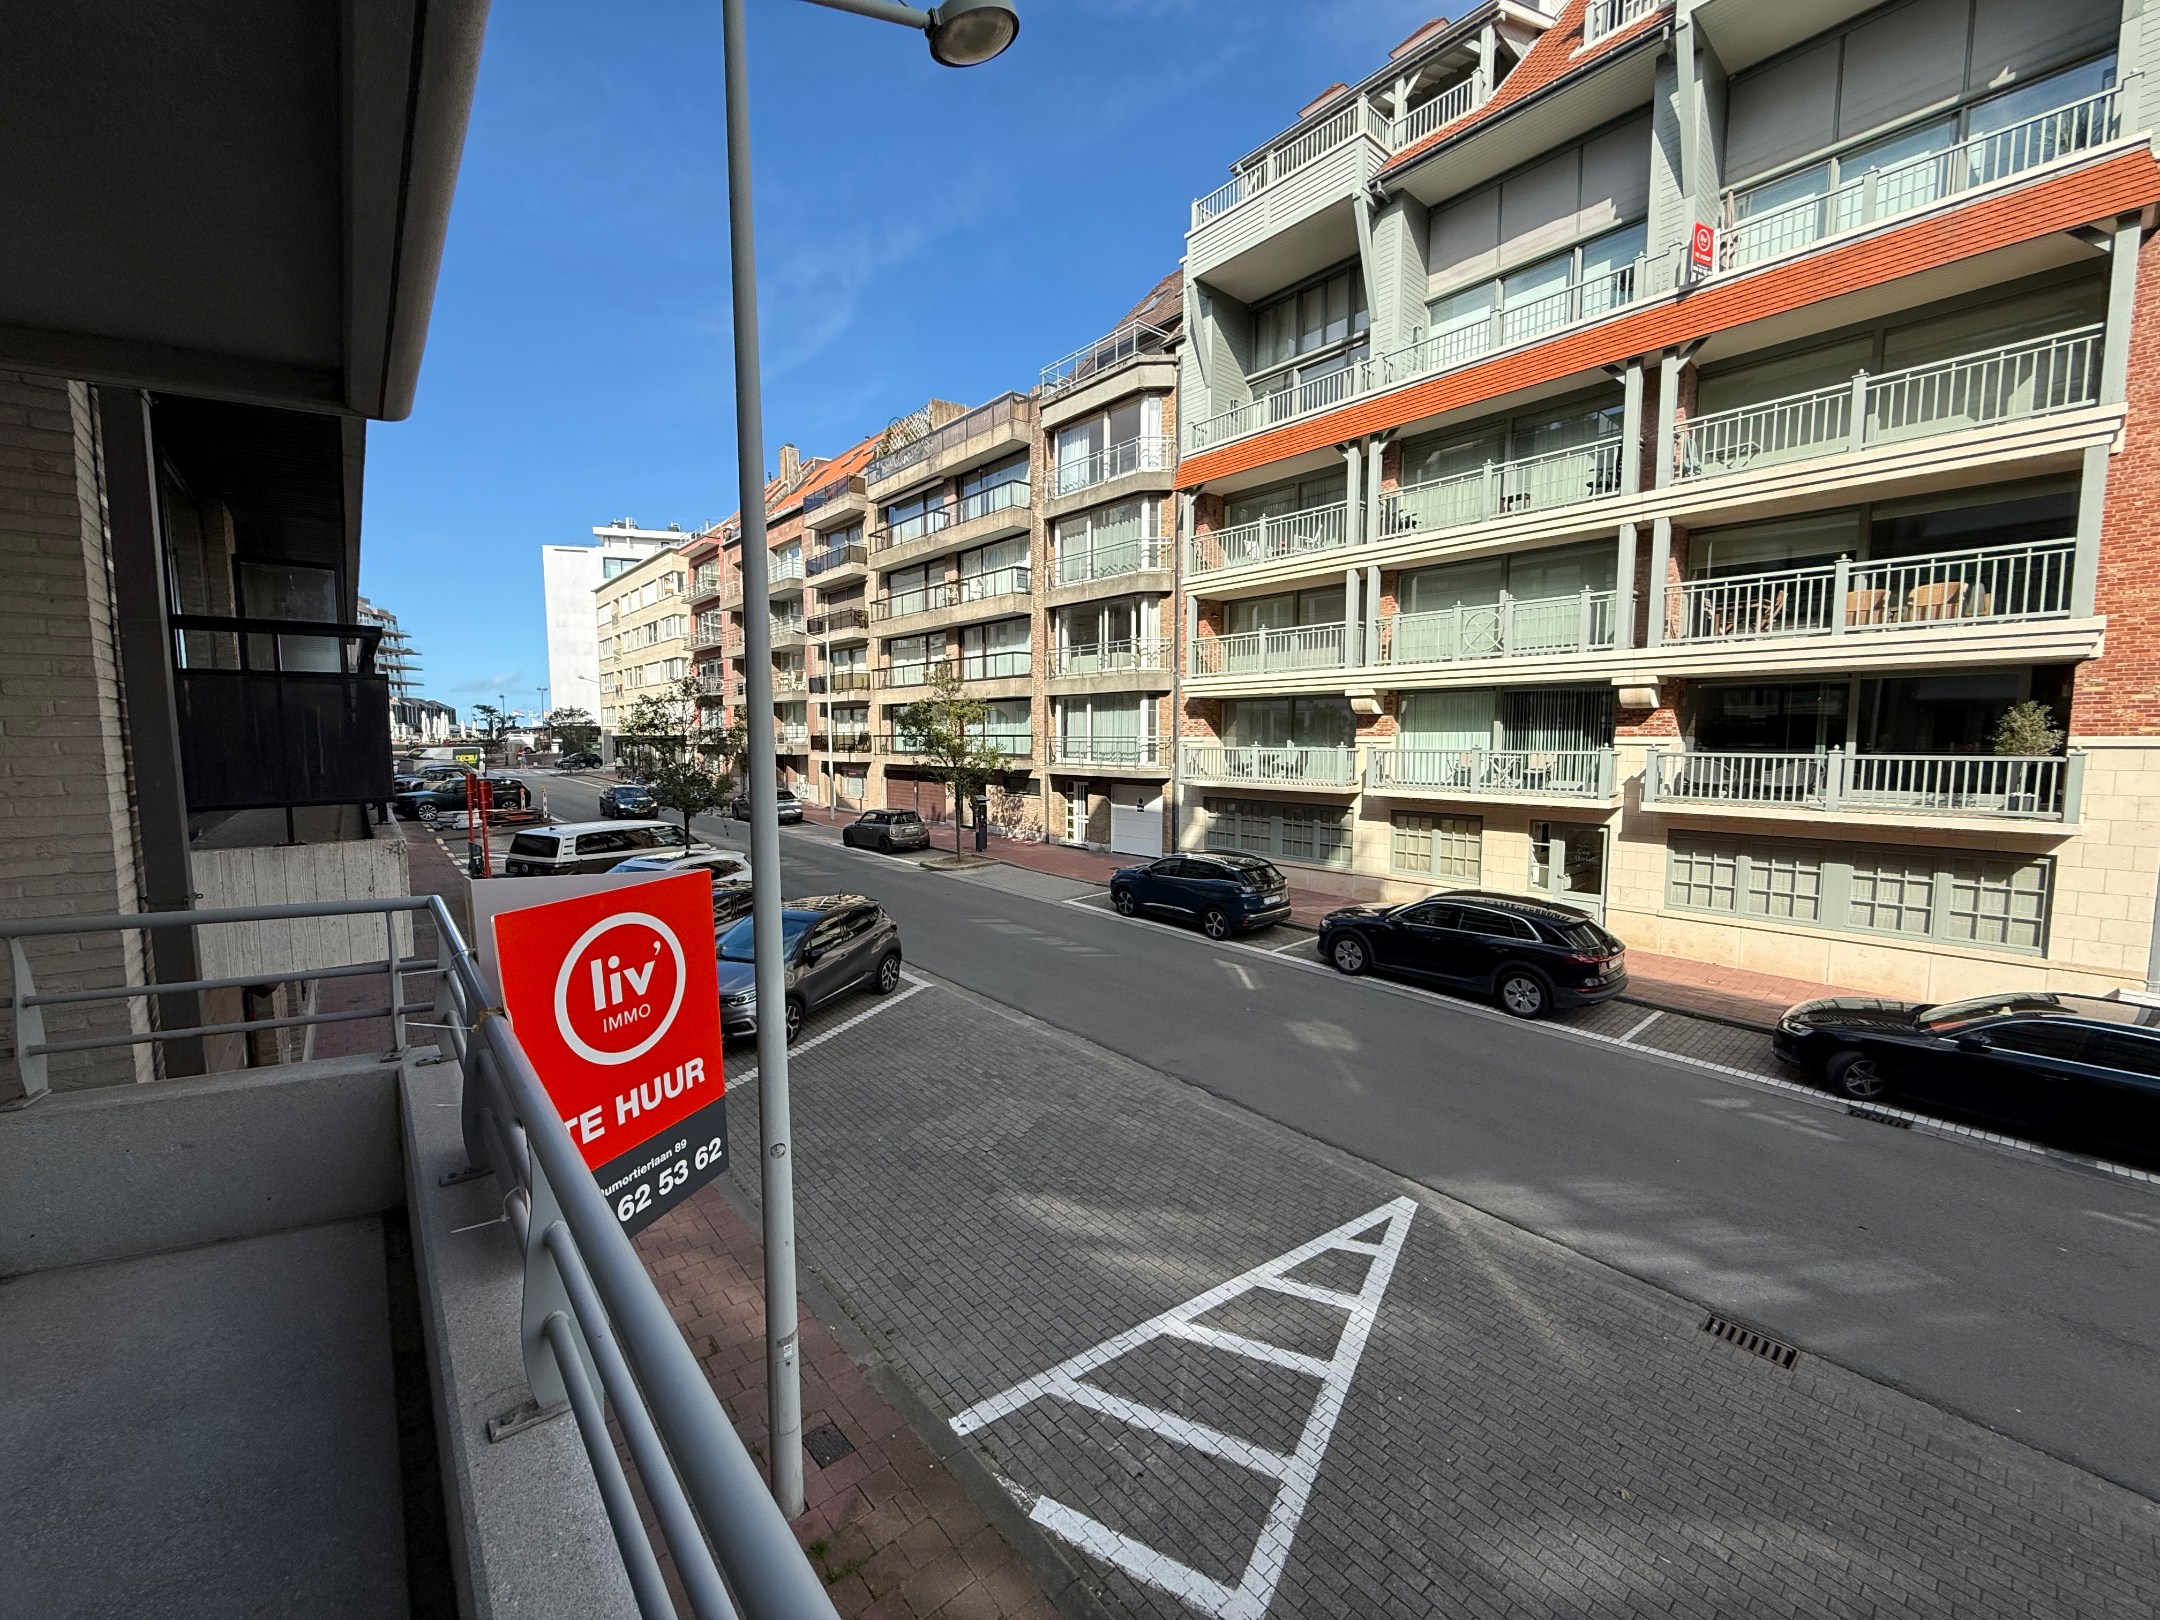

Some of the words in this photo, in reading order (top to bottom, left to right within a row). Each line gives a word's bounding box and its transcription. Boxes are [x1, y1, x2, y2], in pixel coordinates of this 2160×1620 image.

[602, 1003, 651, 1033] IMMO
[615, 1057, 705, 1125] HUUR
[674, 1138, 687, 1153] 89
[617, 1183, 652, 1222] 62
[658, 1159, 689, 1196] 53
[695, 1136, 722, 1171] 62
